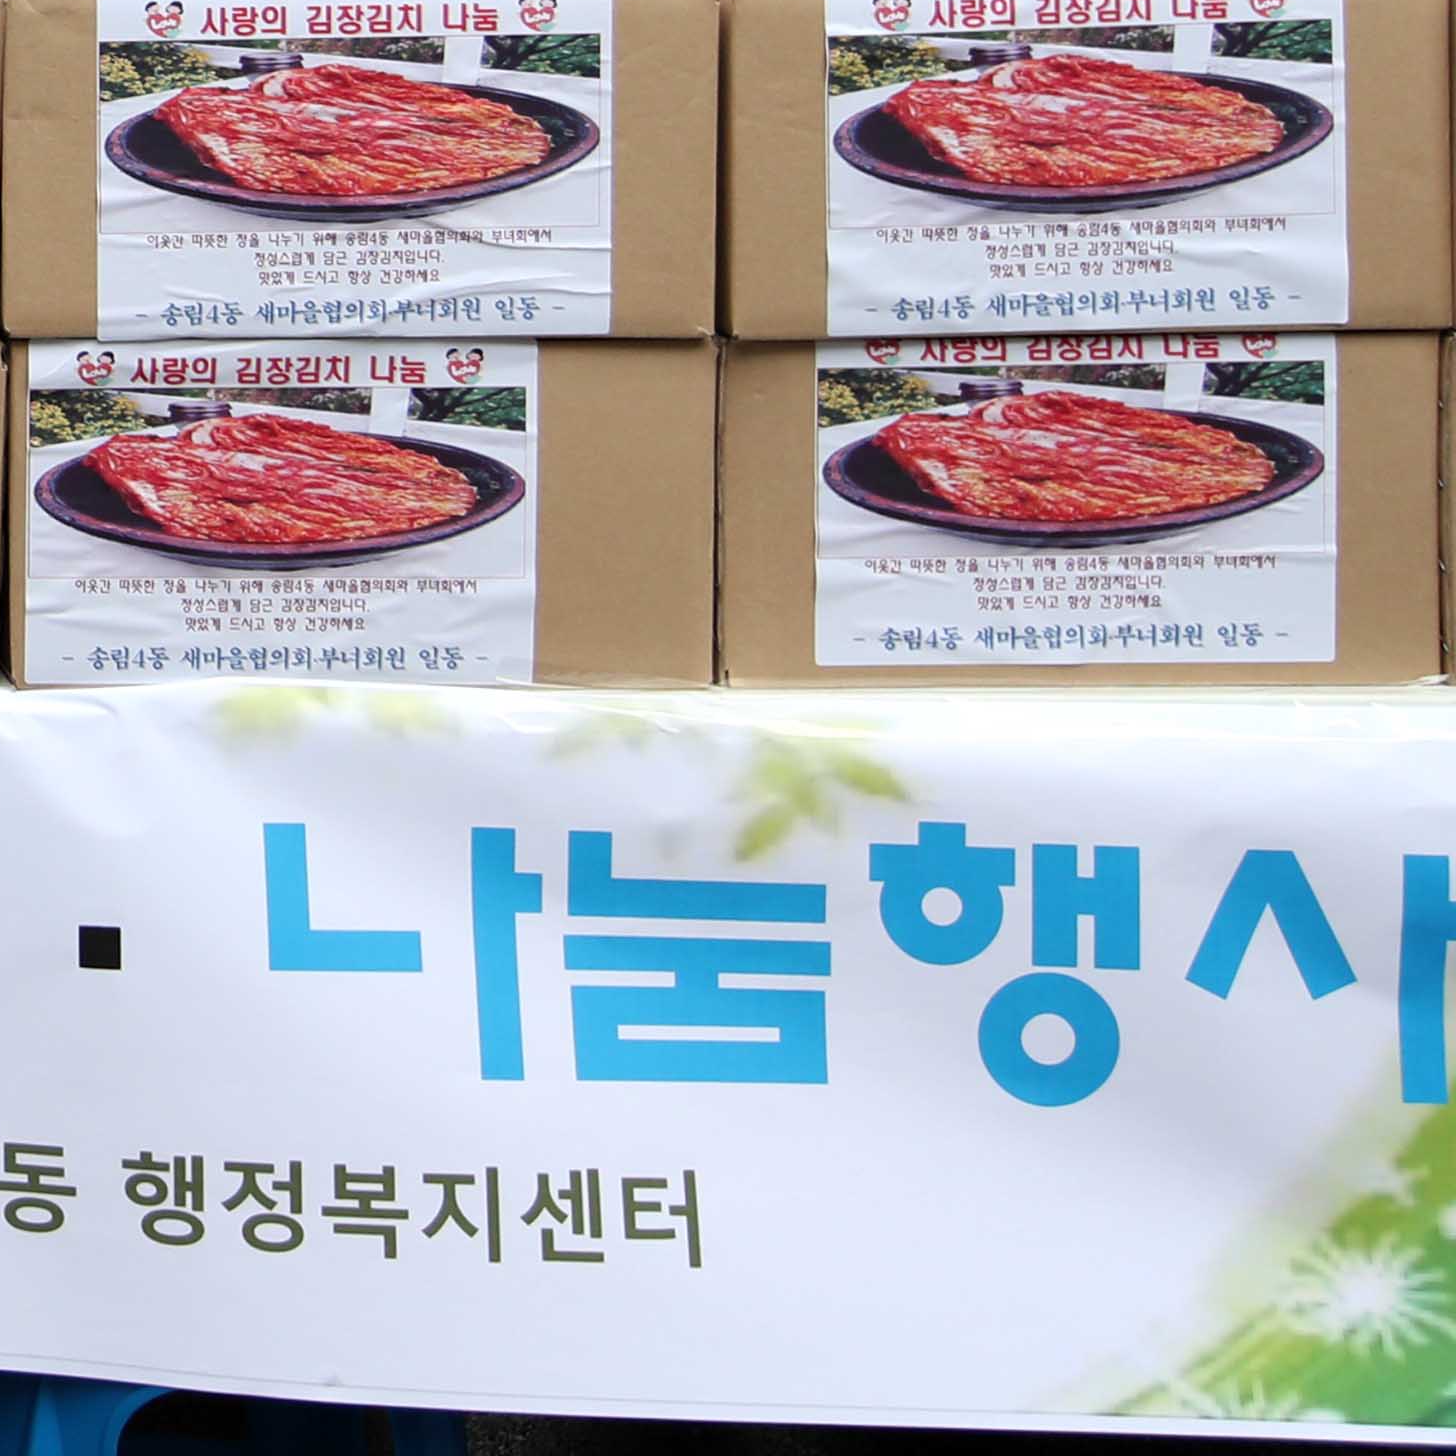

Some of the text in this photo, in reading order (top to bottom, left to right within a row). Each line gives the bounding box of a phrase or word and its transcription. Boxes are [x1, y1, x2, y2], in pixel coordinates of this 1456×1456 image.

[201, 4, 498, 36] 사랑의 김장김치 나눔
[160, 303, 243, 326] 송림4동
[495, 296, 540, 320] 일동
[891, 296, 974, 321] 송림4동
[1229, 286, 1275, 310] 일동
[131, 356, 426, 385] 사랑의 김장김치 나눔
[879, 627, 962, 650] 송림4동
[1218, 623, 1263, 646] 일동
[88, 647, 169, 670] 송림4동
[419, 646, 464, 670] 일동
[264, 821, 1456, 1107] 나눔행사
[121, 1150, 702, 1268] 행정복지센터
